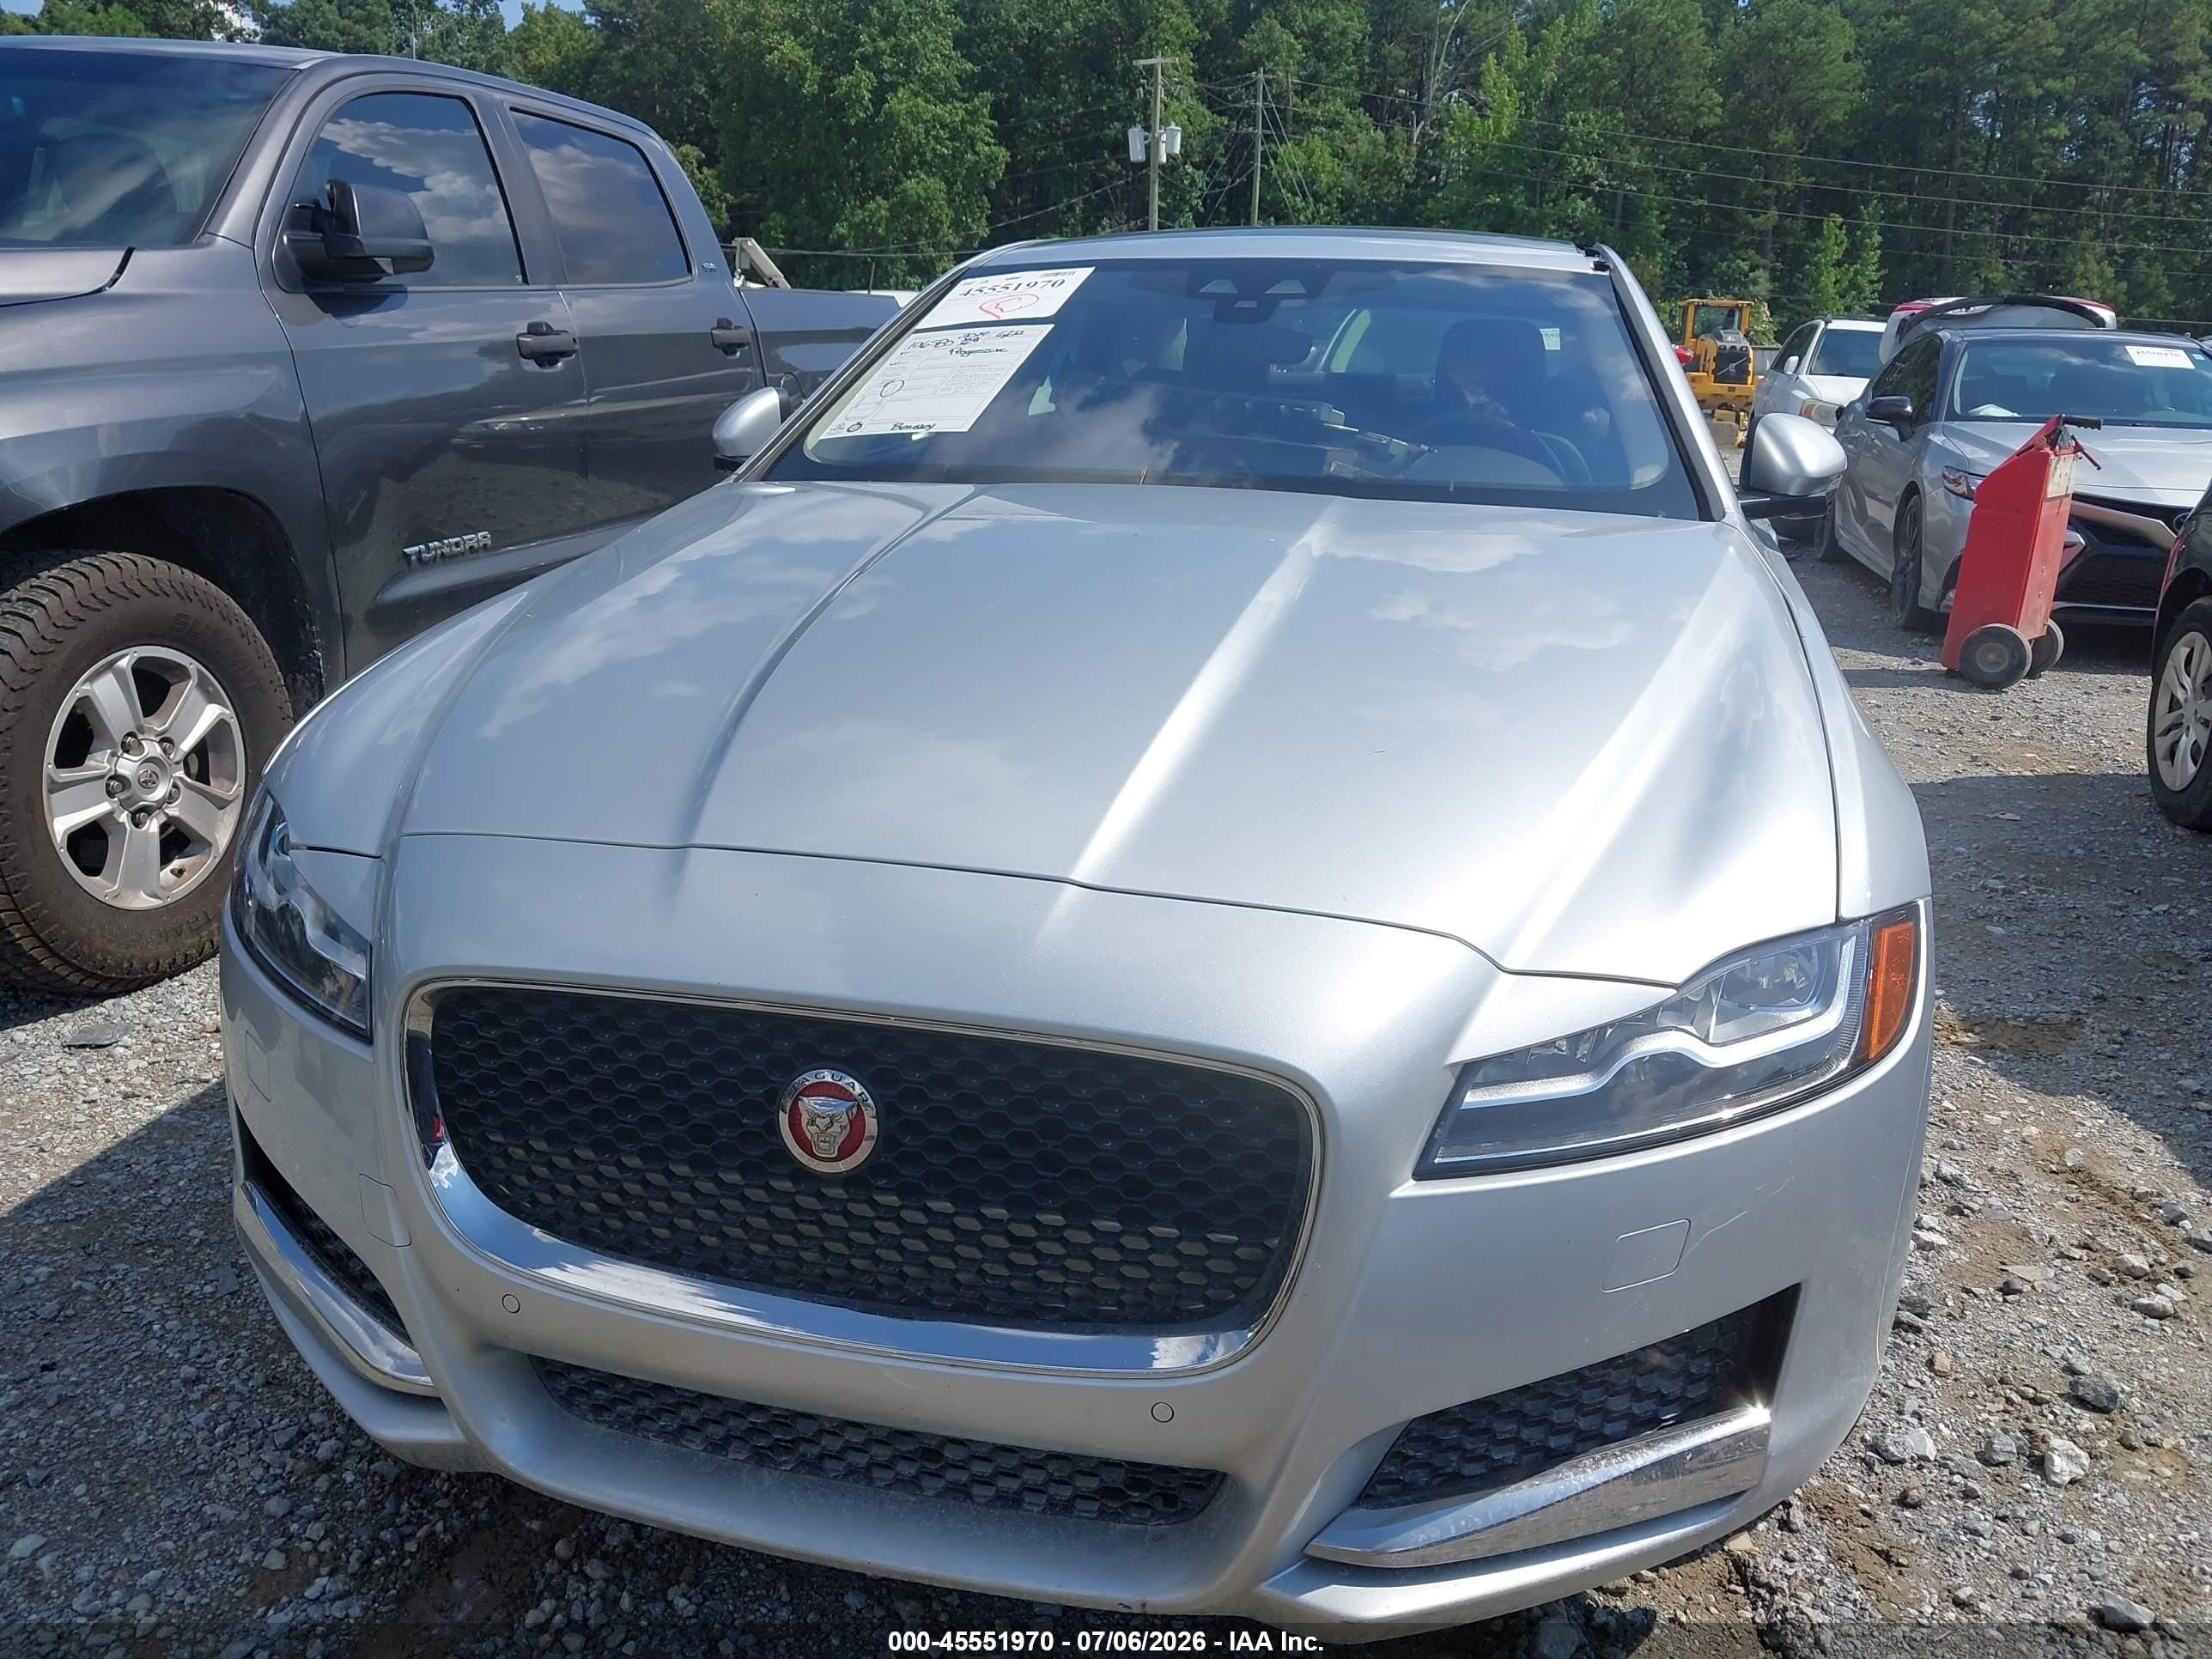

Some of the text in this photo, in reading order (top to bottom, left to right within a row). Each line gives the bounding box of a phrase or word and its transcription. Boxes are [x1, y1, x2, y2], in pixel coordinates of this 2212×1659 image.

[959, 278, 1066, 297] 45551970
[401, 530, 493, 562] TUNDRA
[790, 1071, 871, 1106] JAGUAR
